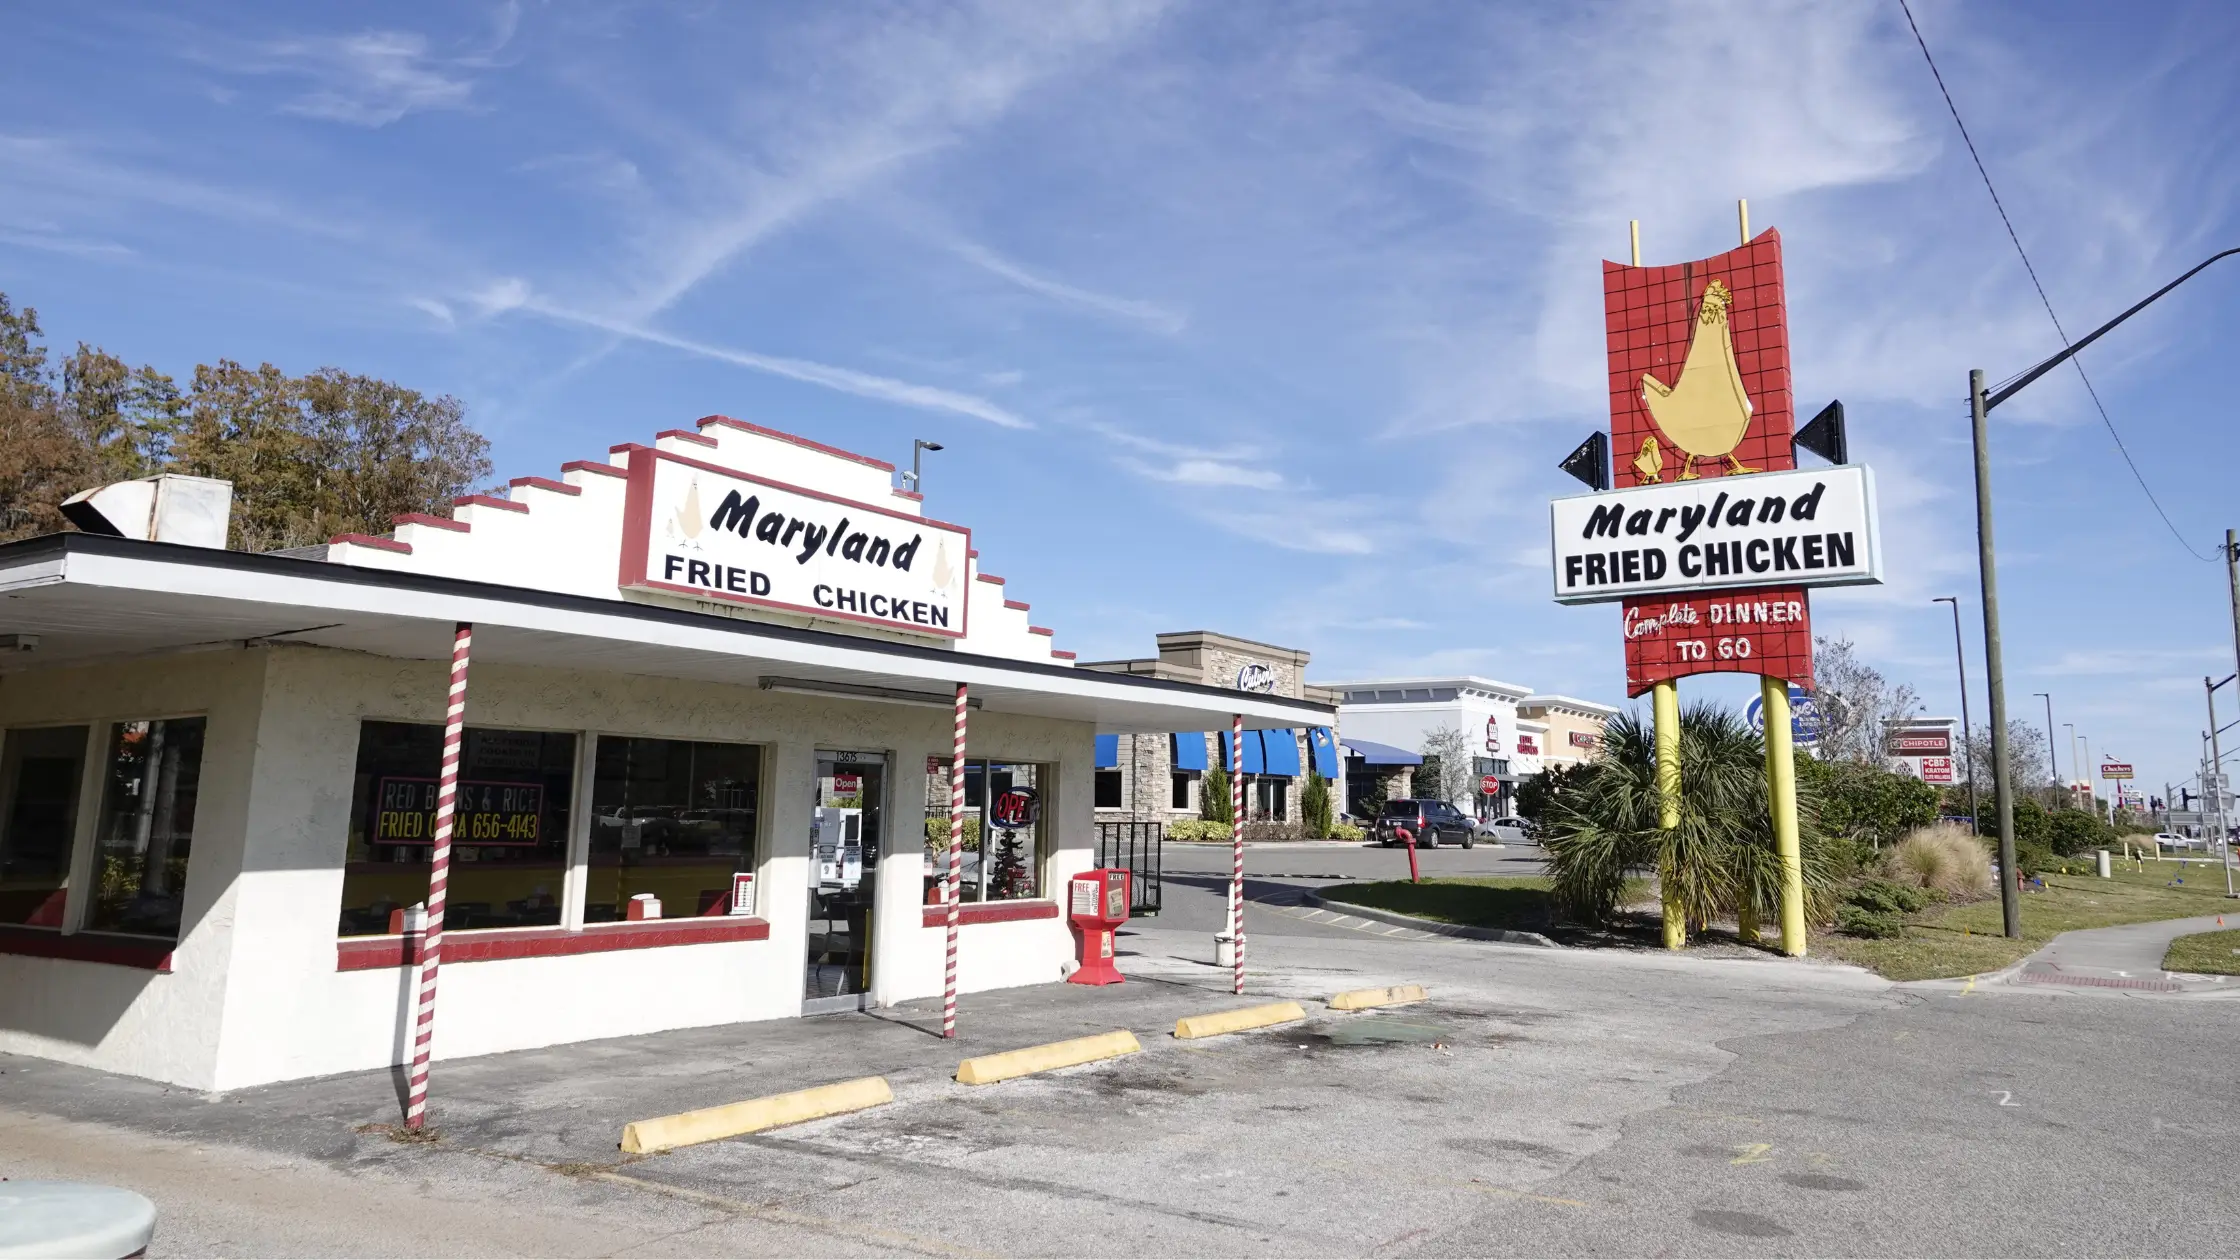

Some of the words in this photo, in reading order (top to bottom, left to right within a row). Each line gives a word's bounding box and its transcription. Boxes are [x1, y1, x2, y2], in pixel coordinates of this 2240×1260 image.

[1582, 482, 1827, 542] Maryland
[710, 489, 922, 573] Maryland
[1565, 547, 1668, 588] FRIED
[1678, 532, 1856, 578] CHICKEN
[664, 554, 771, 597] FRIED
[813, 584, 949, 628] CHICKEN
[1623, 602, 1700, 640] Complete
[1709, 601, 1803, 625] DINNER
[1676, 640, 1707, 661] TO
[1717, 637, 1752, 659] GO
[385, 783, 416, 809] RED
[424, 784, 474, 811] BNS
[502, 787, 538, 812] RICE
[835, 778, 857, 788] Open
[1482, 780, 1498, 789] STOP
[379, 811, 424, 838] FRIED
[428, 812, 468, 839] ORA
[472, 813, 538, 839] 656-4143
[1075, 882, 1090, 893] FREE
